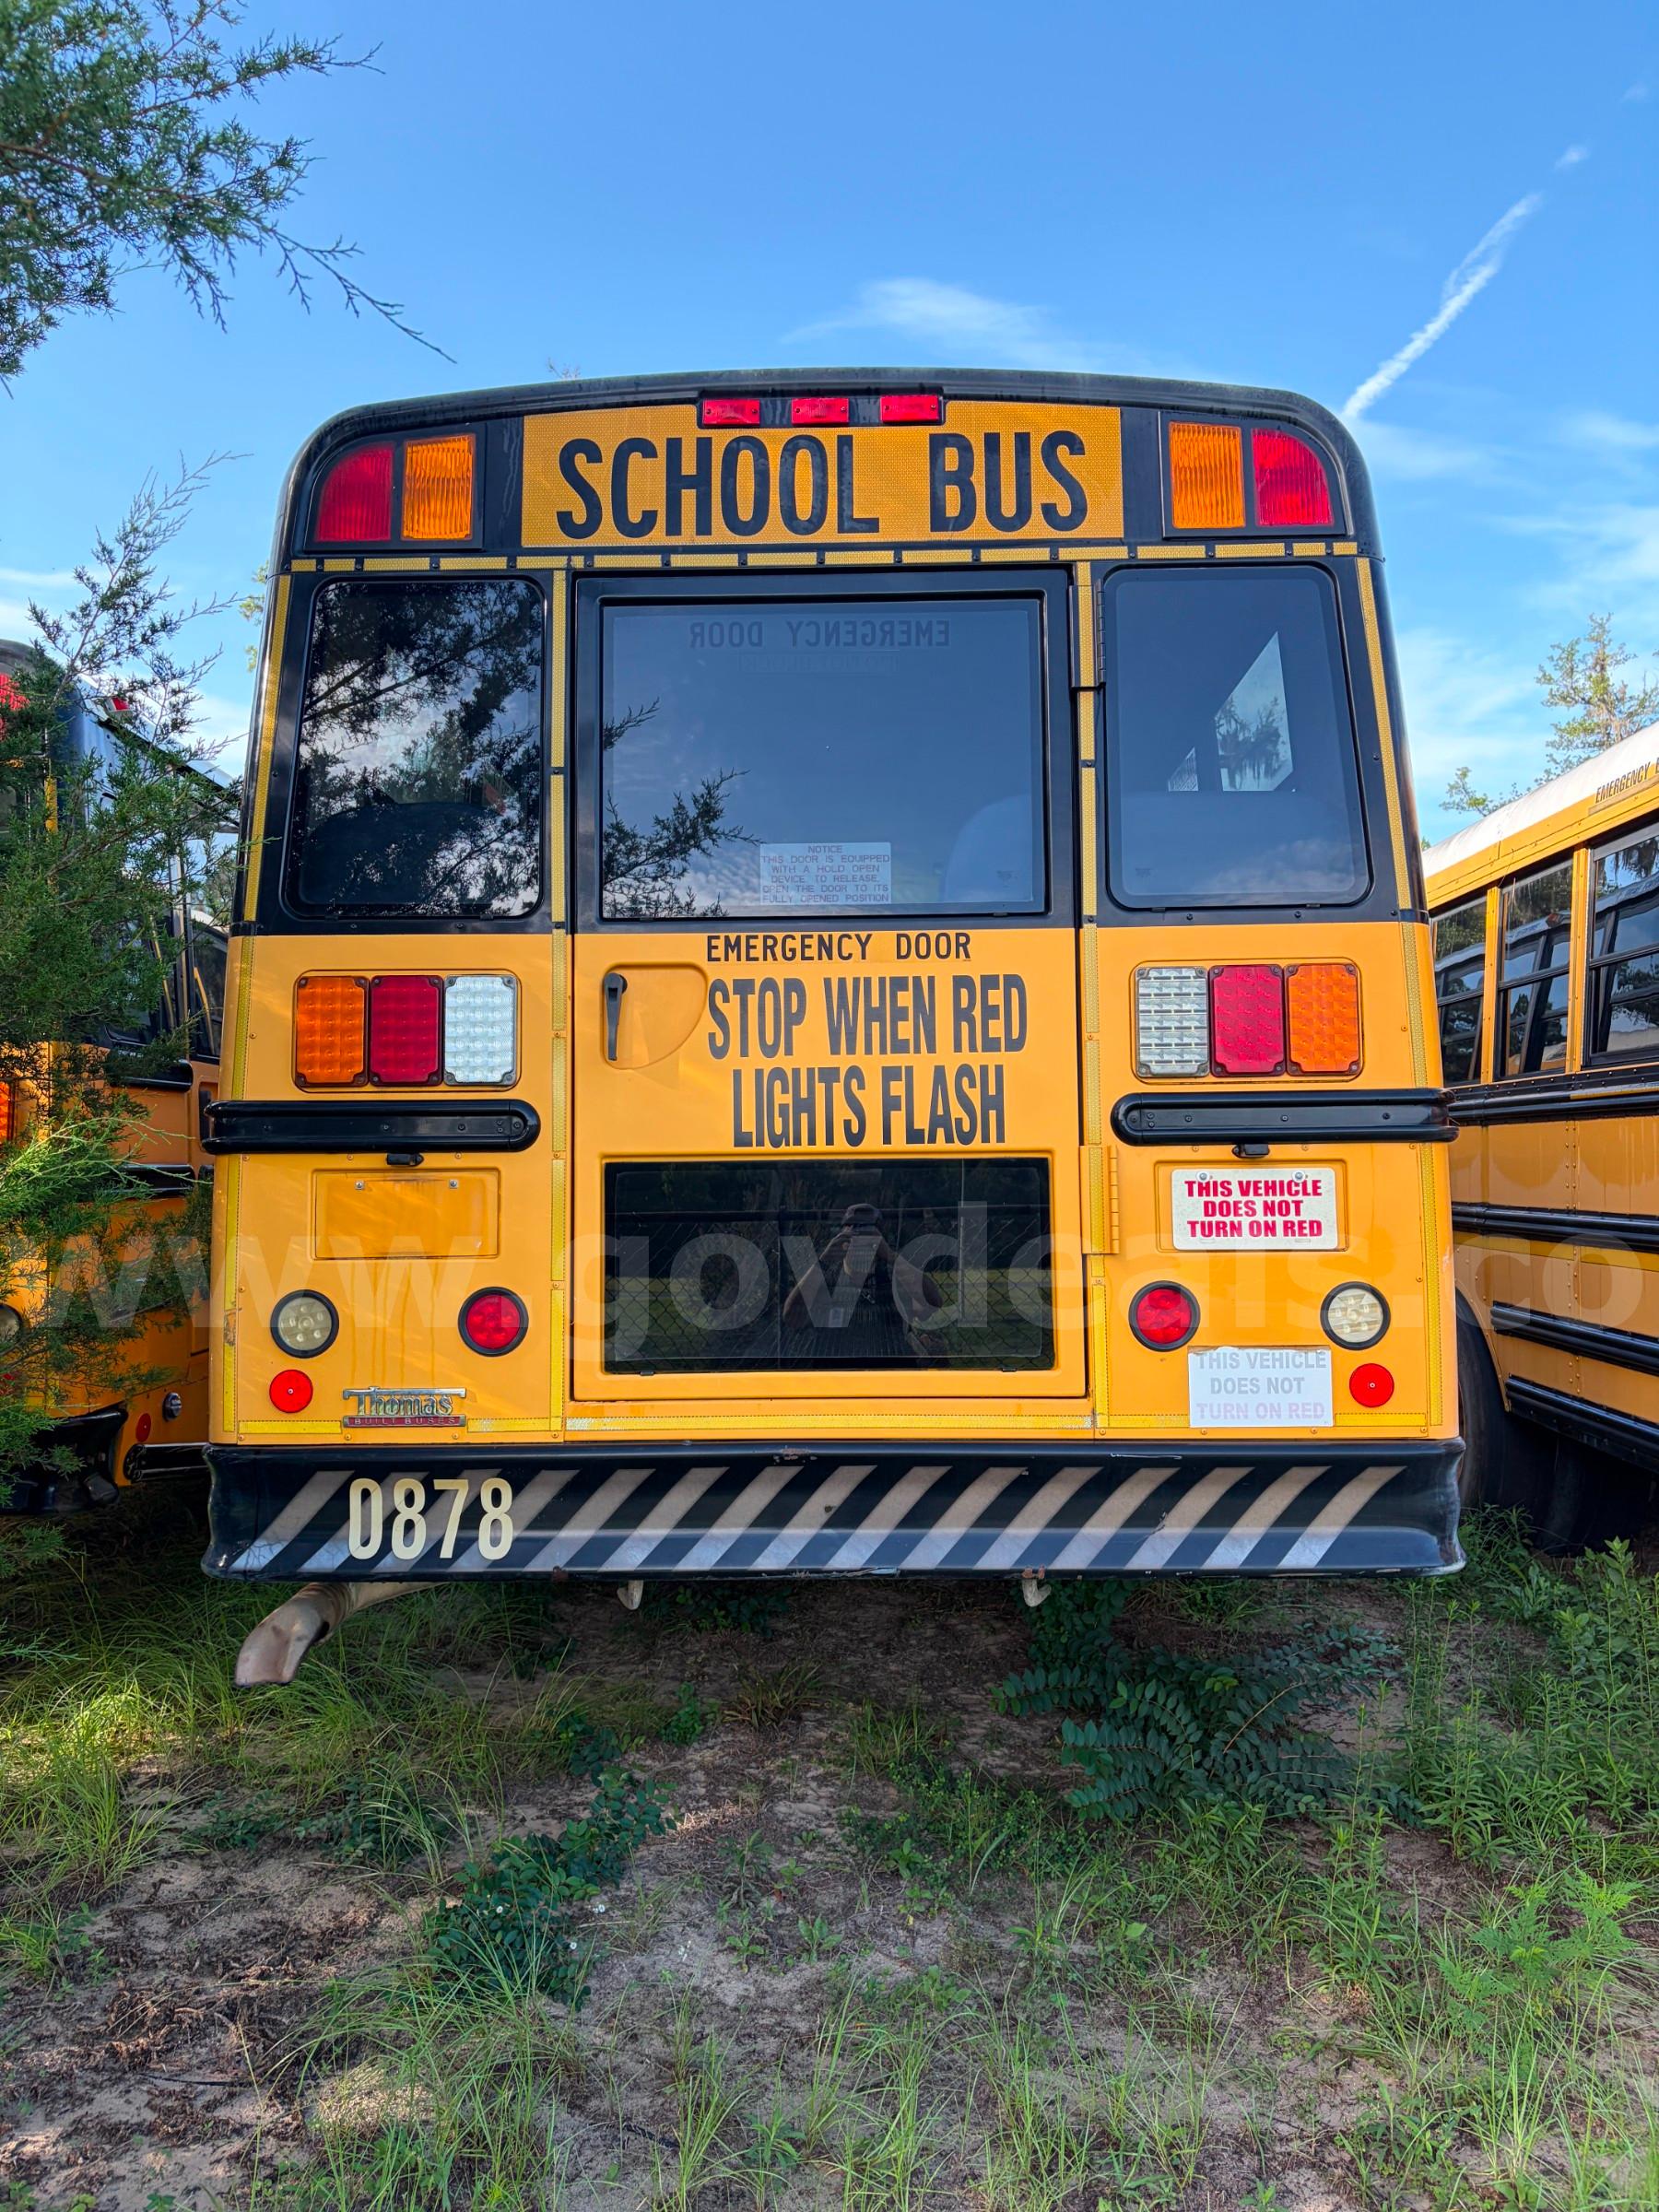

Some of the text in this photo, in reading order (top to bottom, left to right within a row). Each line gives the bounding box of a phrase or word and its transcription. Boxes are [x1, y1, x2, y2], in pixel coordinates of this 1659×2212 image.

[556, 430, 1088, 539] SCHOOL BUS
[1595, 761, 1651, 804] EMERGENCY
[807, 845, 843, 853] NOTICE
[761, 855, 783, 864] THIS
[826, 854, 834, 863] IS
[841, 854, 890, 863] EQUIPPED
[771, 865, 795, 874] WITH
[817, 865, 845, 873] HOLD
[852, 865, 879, 873] OPEN
[815, 875, 827, 883] TO
[762, 884, 888, 893] OPEN THE DOOR TO ITS
[762, 893, 888, 903] FULLY OPENED POSITION
[707, 932, 971, 962] EMERGENCY DOOR
[708, 973, 1028, 1060] STOP WHEN RED
[733, 1064, 1006, 1149] LIGHTS FLASH
[1184, 1179, 1323, 1197] THIS VEHICLE
[1203, 1199, 1304, 1218] DOES NOT
[1187, 1219, 1323, 1238] TURN ON RED
[1196, 1350, 1327, 1370] THIS VEHICLE
[1210, 1376, 1305, 1394] DOES NOT
[343, 1385, 466, 1416] Thomas
[1196, 1402, 1325, 1419] TURN ON RED
[354, 1417, 457, 1426] BUILT BUSES
[348, 1477, 513, 1560] 0878
